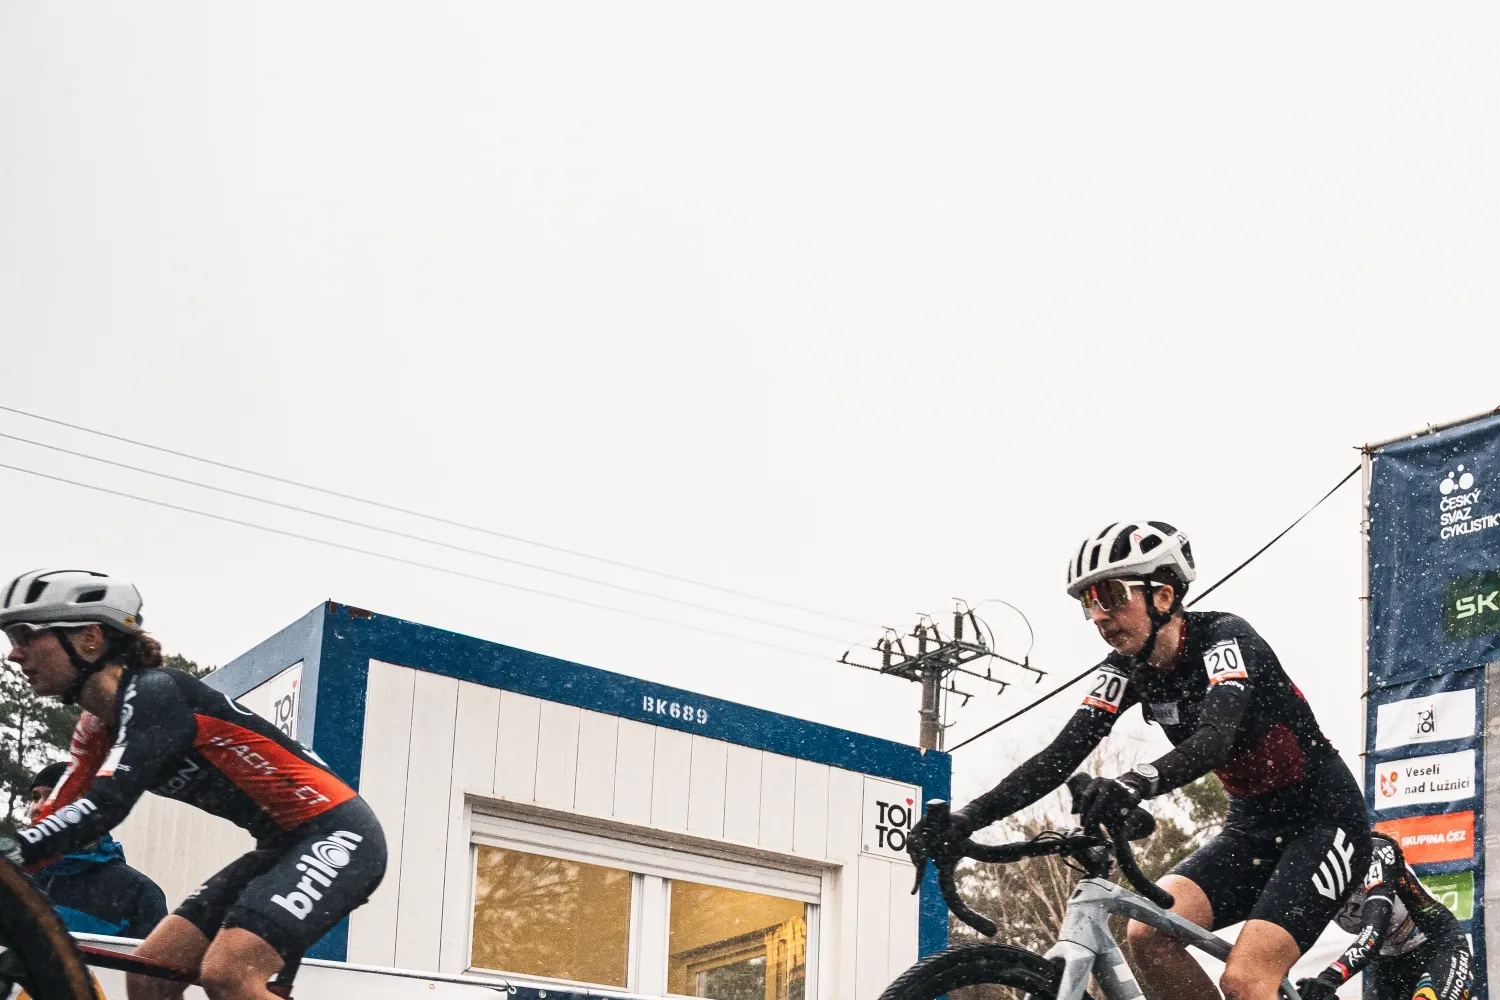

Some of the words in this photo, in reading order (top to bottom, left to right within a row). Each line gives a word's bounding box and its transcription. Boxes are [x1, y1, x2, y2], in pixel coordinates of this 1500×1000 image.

[1440, 488, 1481, 512] ČESKÝ
[1440, 507, 1472, 526] SVAZ
[1208, 648, 1239, 675] 20
[1089, 673, 1122, 702] 20
[643, 695, 708, 725] BK689
[1405, 763, 1440, 778] Veselí
[1404, 782, 1425, 795] nad
[1430, 776, 1470, 793] Lužnicí
[875, 824, 911, 851] TO
[1401, 833, 1445, 847] SKUPINA
[1446, 829, 1467, 842] ČEZ
[270, 830, 364, 921] brilon
